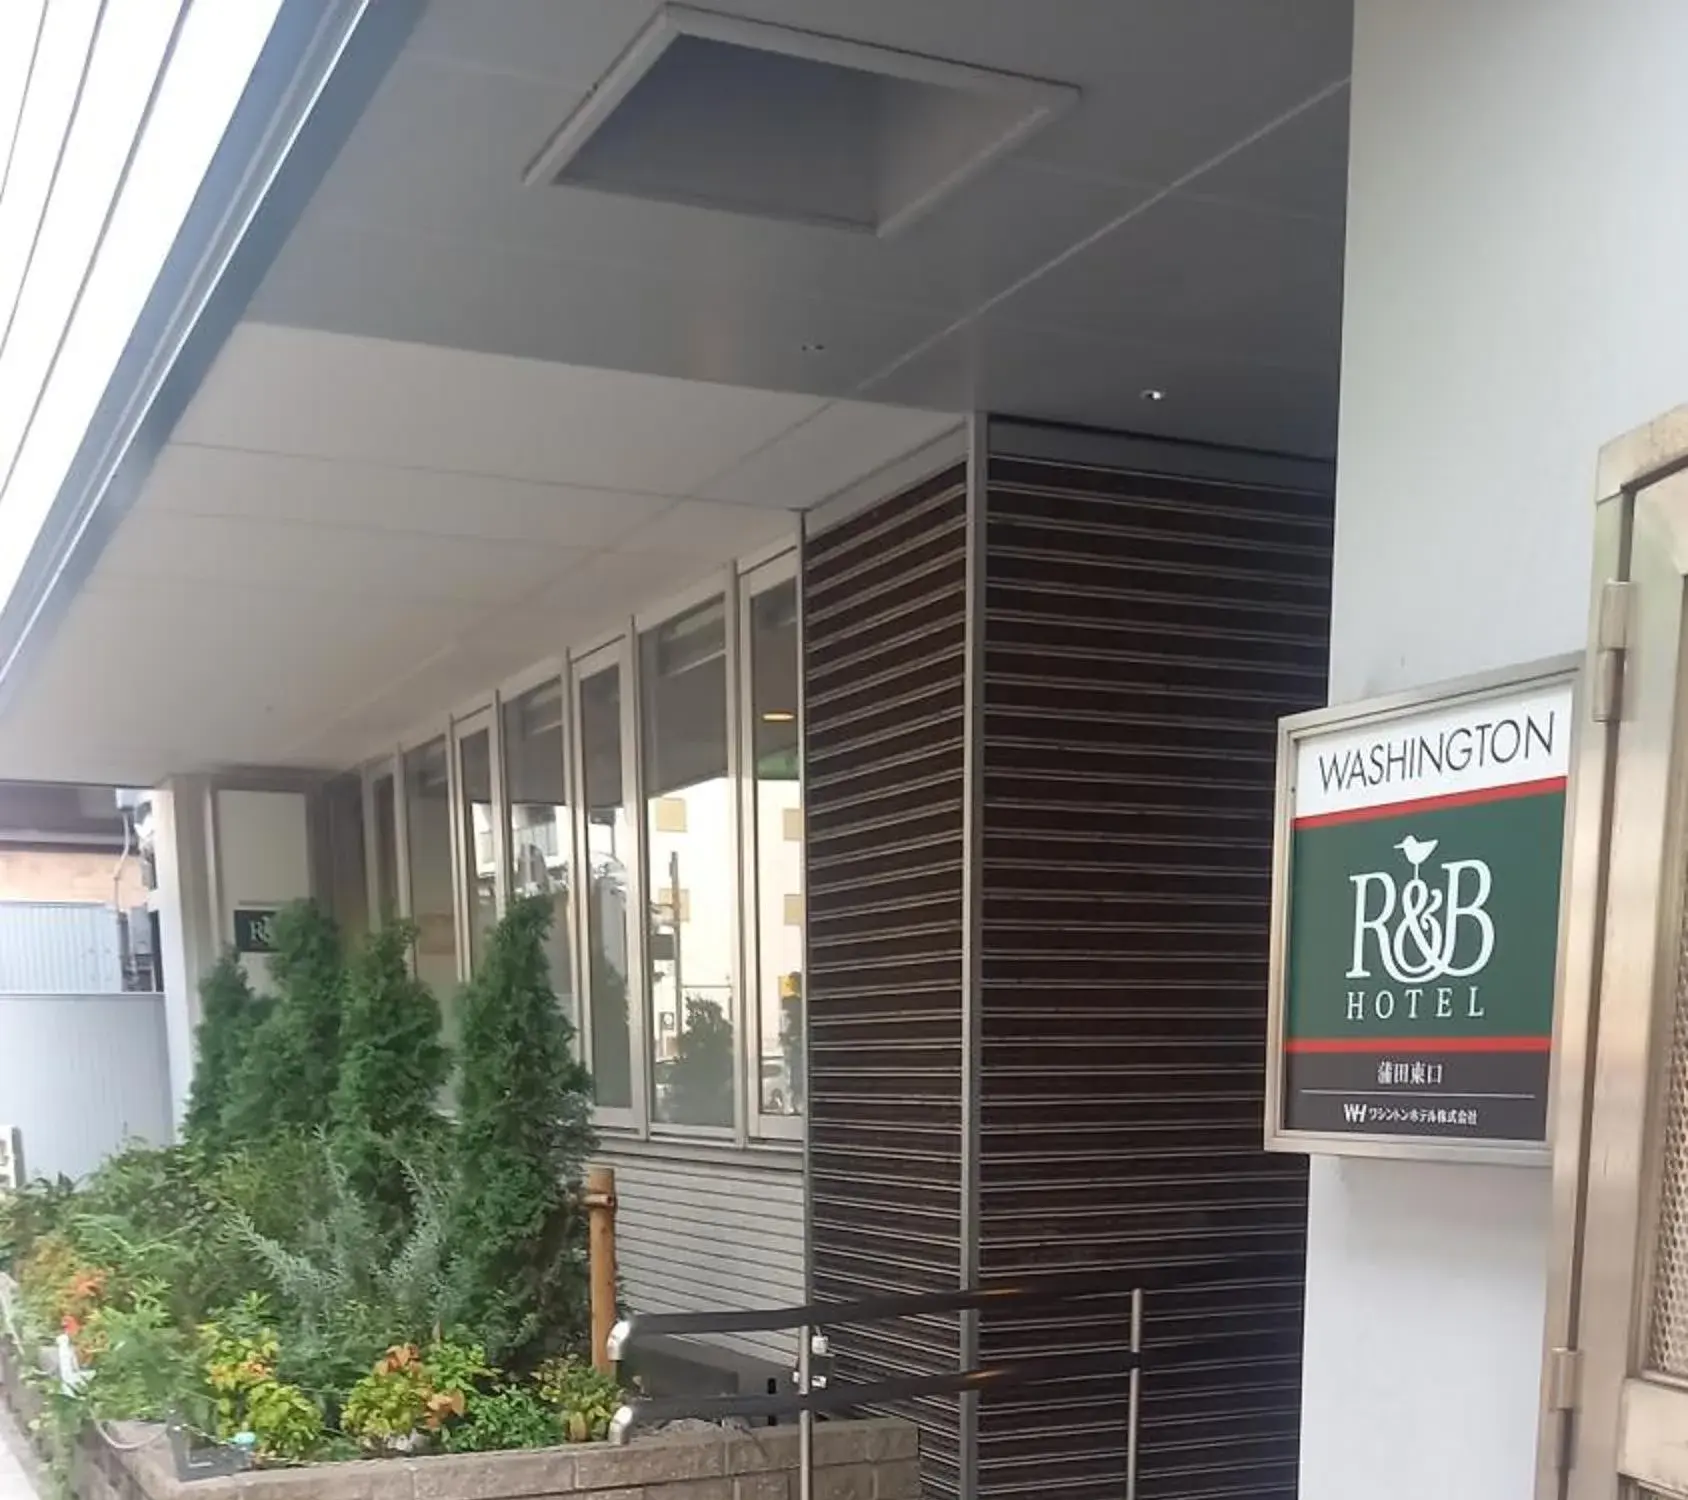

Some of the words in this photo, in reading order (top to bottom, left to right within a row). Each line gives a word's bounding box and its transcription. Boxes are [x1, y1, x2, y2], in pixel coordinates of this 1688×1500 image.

[1319, 710, 1555, 794] WASHINGTON
[1346, 859, 1495, 983] R&B
[1347, 986, 1485, 1020] HOTEL
[1377, 1060, 1443, 1085] 蒲田東口
[1368, 1106, 1478, 1126] ワシントンホテル株式会社
